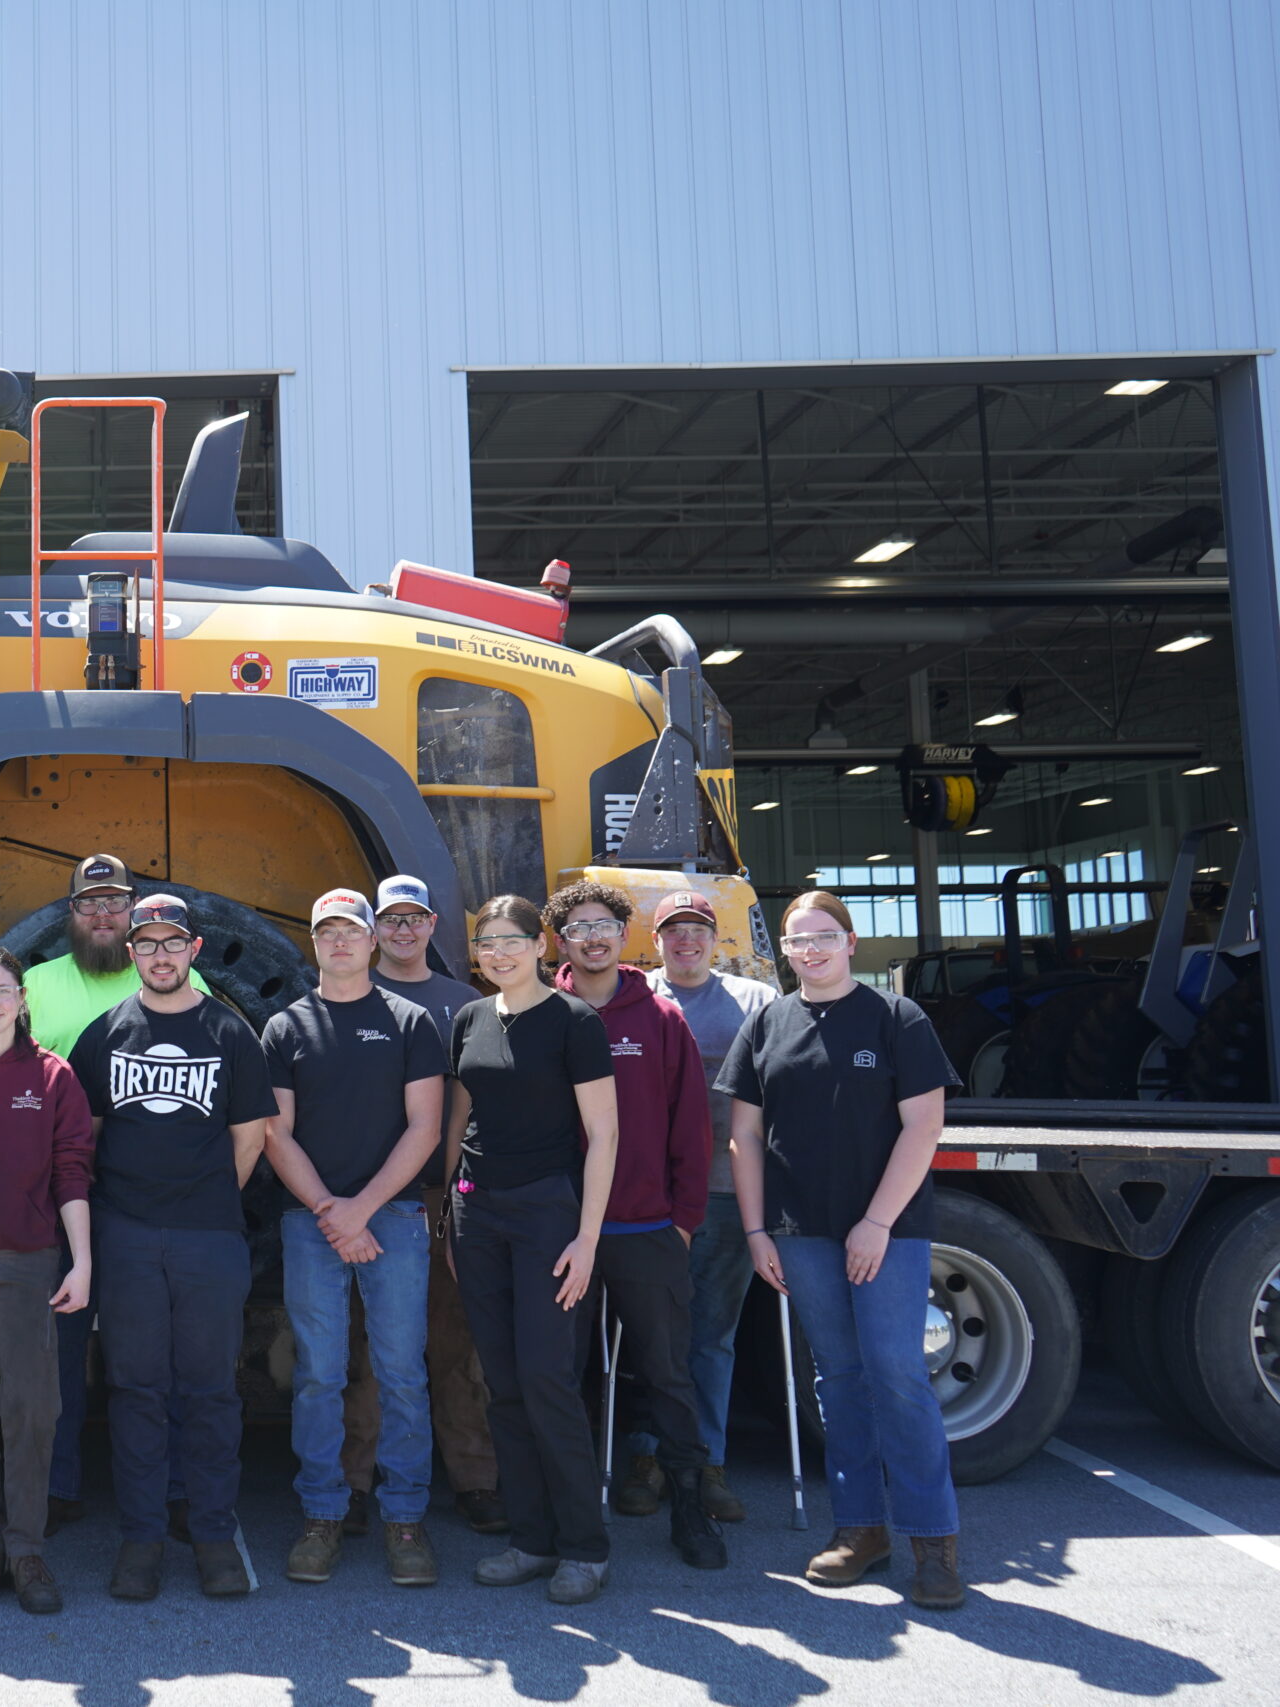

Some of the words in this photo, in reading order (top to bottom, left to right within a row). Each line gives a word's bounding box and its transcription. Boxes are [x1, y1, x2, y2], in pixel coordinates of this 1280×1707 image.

[5, 611, 182, 630] VOO
[480, 644, 576, 677] LCSWMA
[300, 676, 365, 693] HIGHWAY
[924, 747, 976, 760] HARVEY
[110, 1055, 221, 1110] DRYDENE
